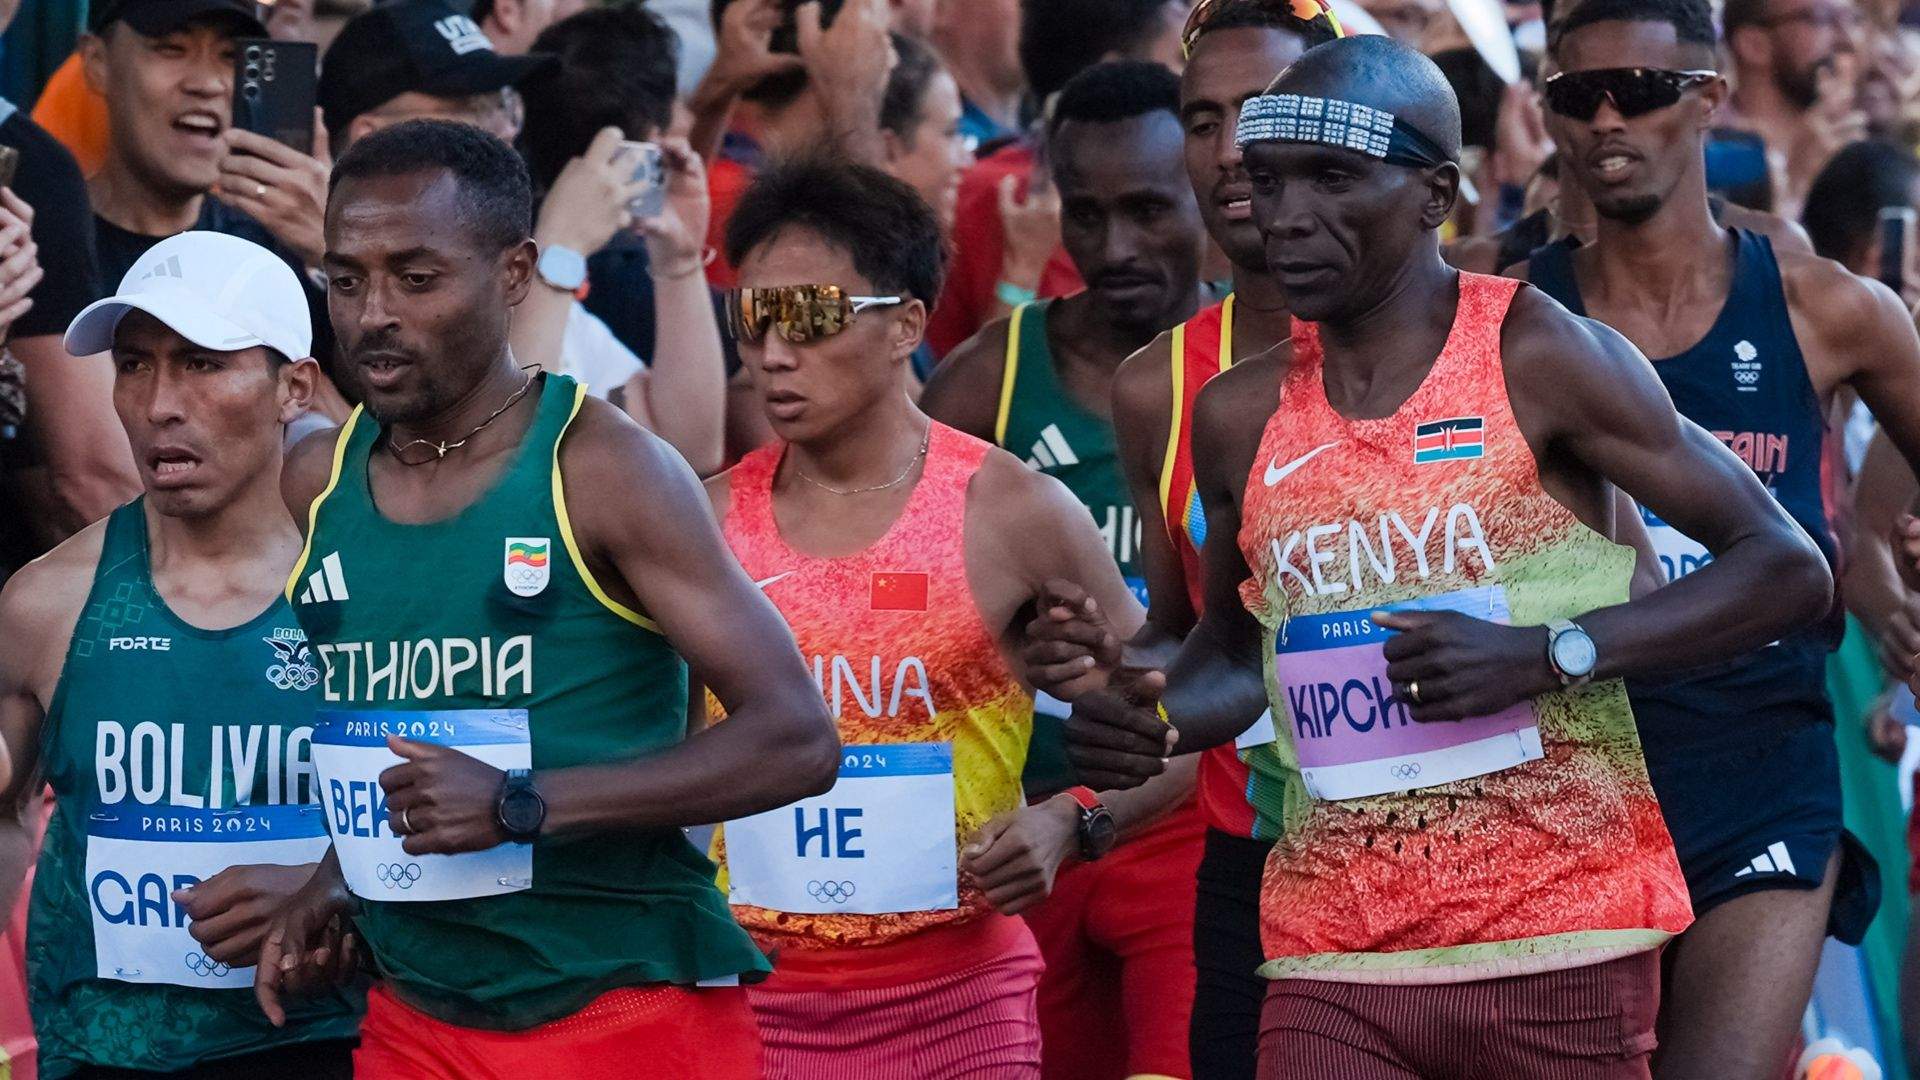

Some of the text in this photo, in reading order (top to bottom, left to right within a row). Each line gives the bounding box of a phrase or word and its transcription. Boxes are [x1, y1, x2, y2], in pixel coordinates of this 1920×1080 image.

[1271, 503, 1495, 598] KENYA
[109, 637, 171, 651] FORTE
[273, 628, 308, 641] BOLI
[1322, 619, 1371, 639] PARIS
[317, 635, 532, 701] ETHIOPIA
[814, 655, 937, 719] INA
[346, 721, 455, 738] PARIS 2024
[1288, 676, 1407, 739] KIPCH
[95, 720, 319, 810] BOLIVIA
[839, 754, 887, 768] 024
[142, 817, 270, 833] PARIS 2024
[330, 779, 402, 838] BEK
[795, 807, 865, 858] HE
[91, 870, 202, 928] GAR
